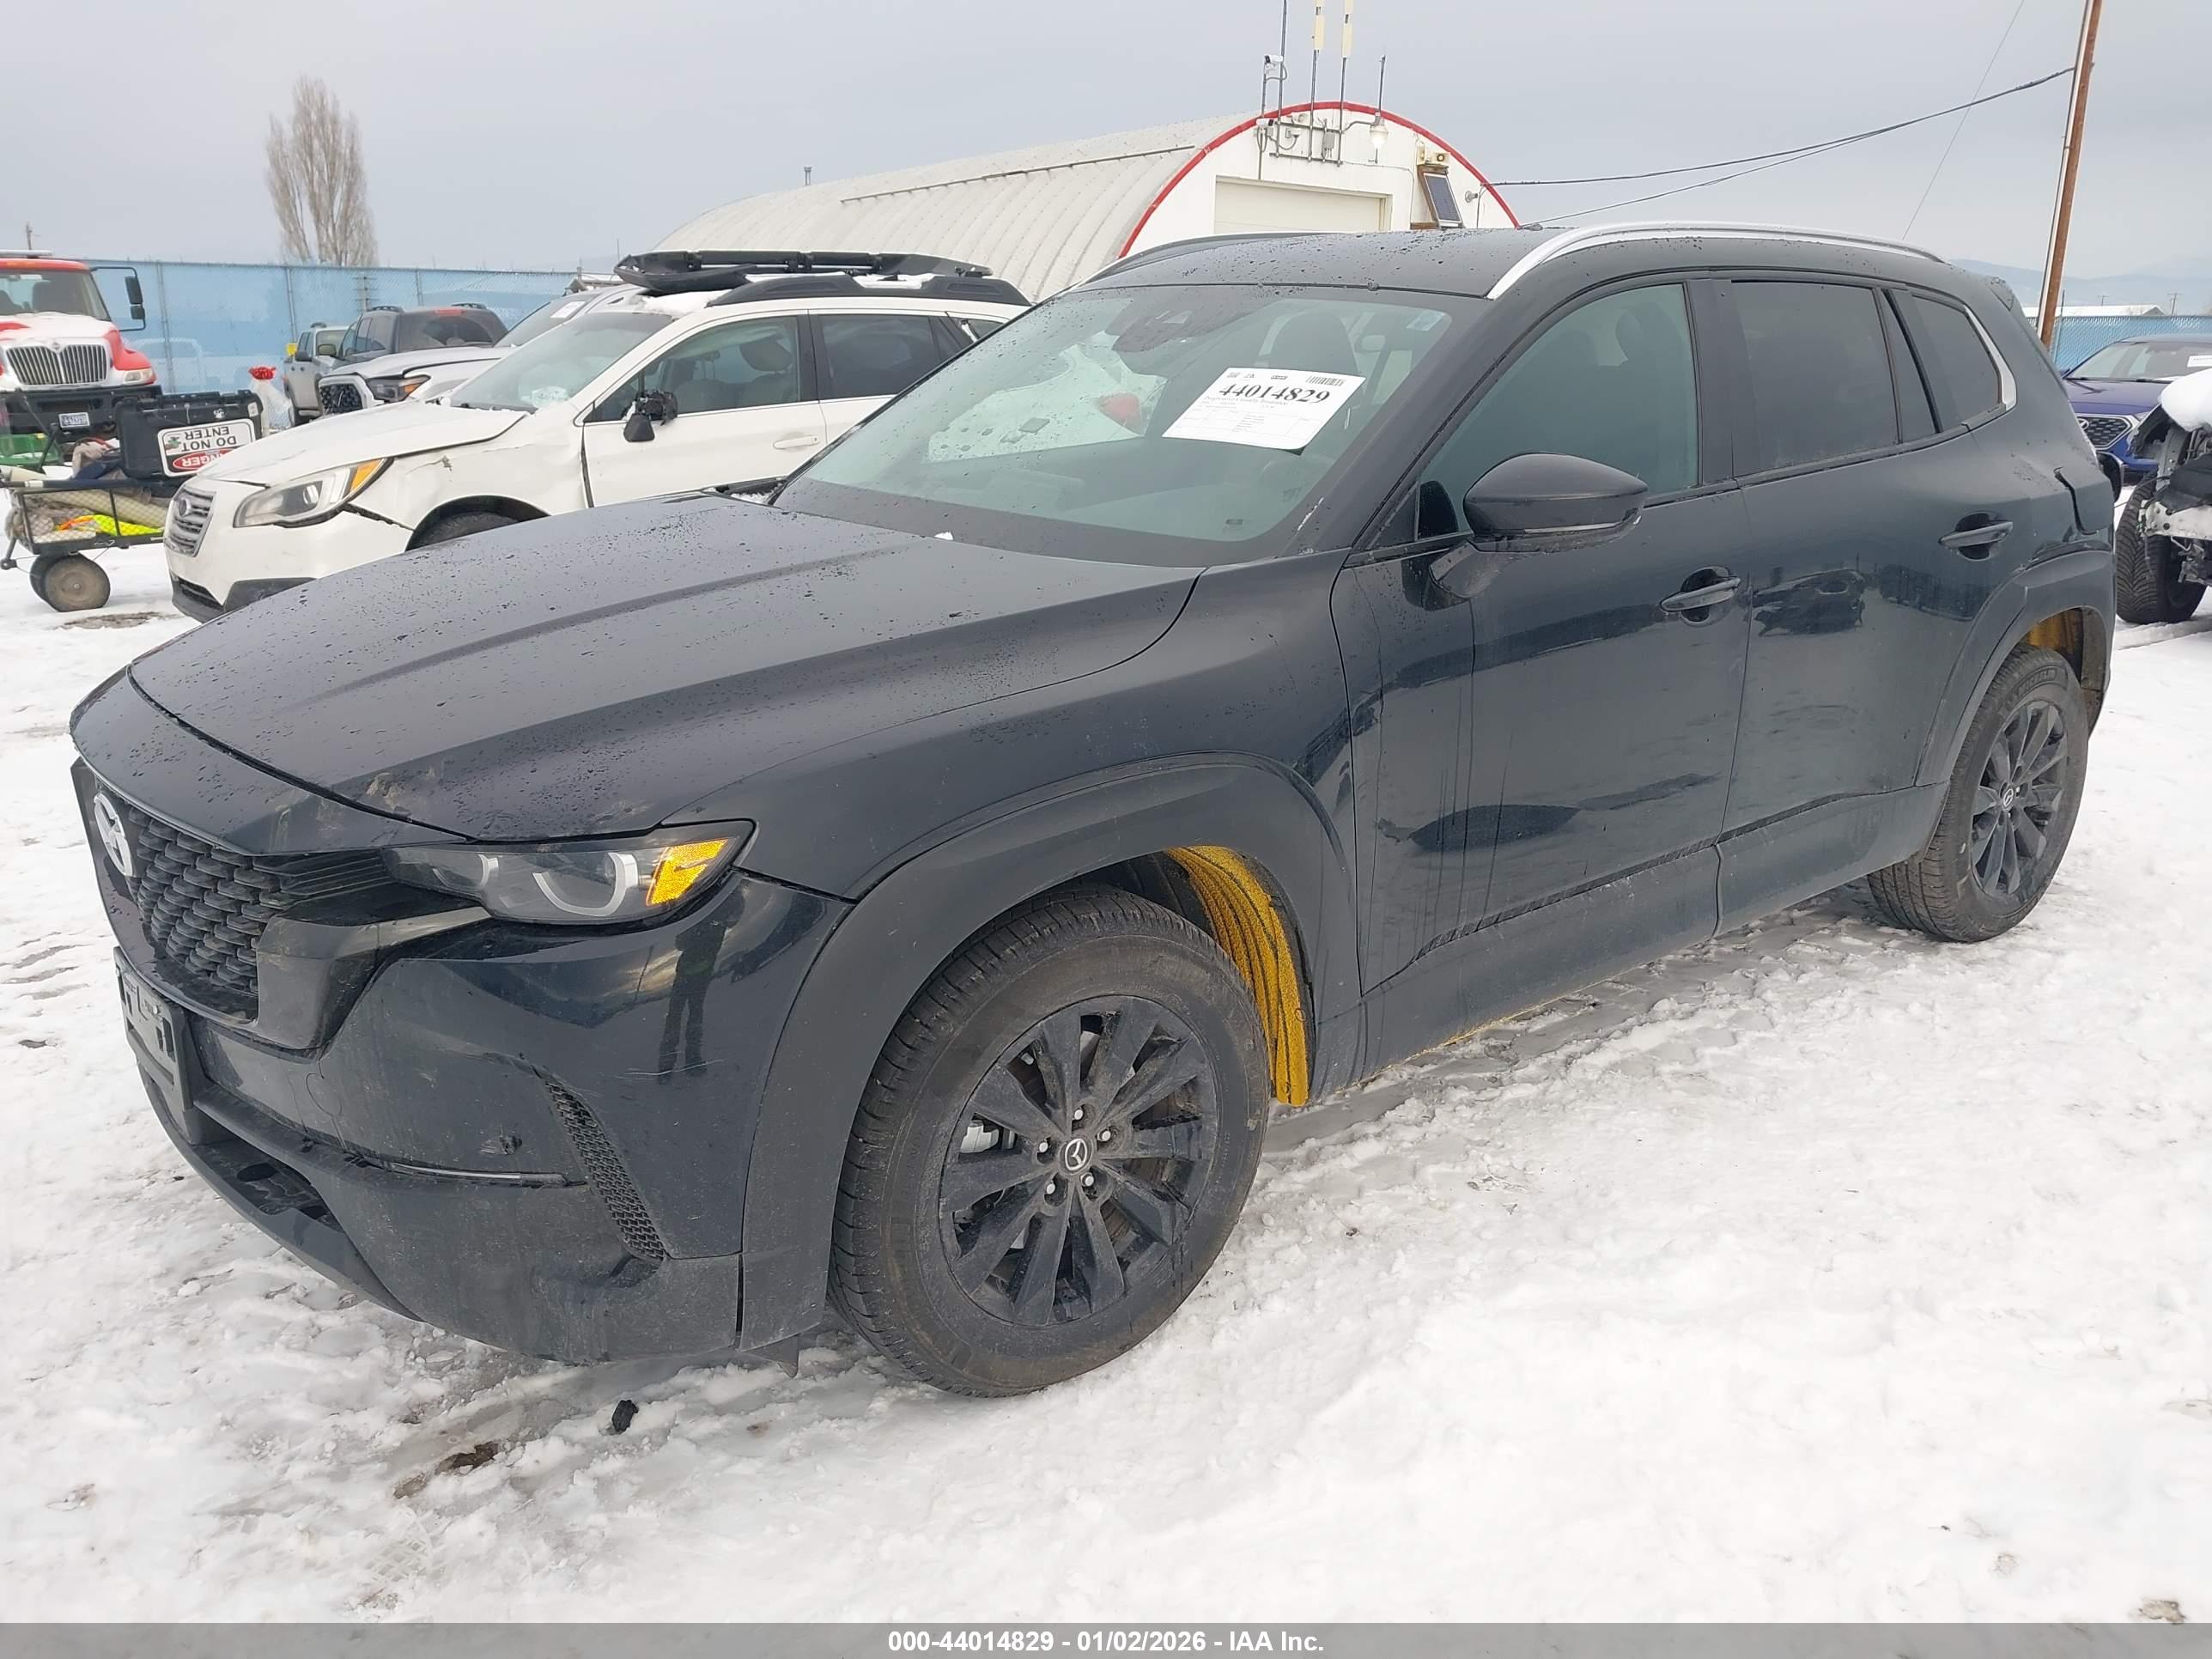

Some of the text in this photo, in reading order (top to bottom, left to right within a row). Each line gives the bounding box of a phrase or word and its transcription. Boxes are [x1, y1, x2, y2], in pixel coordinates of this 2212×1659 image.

[1218, 384, 1330, 404] 44014829
[185, 425, 230, 441] ENTER
[181, 435, 237, 453] DO NOT
